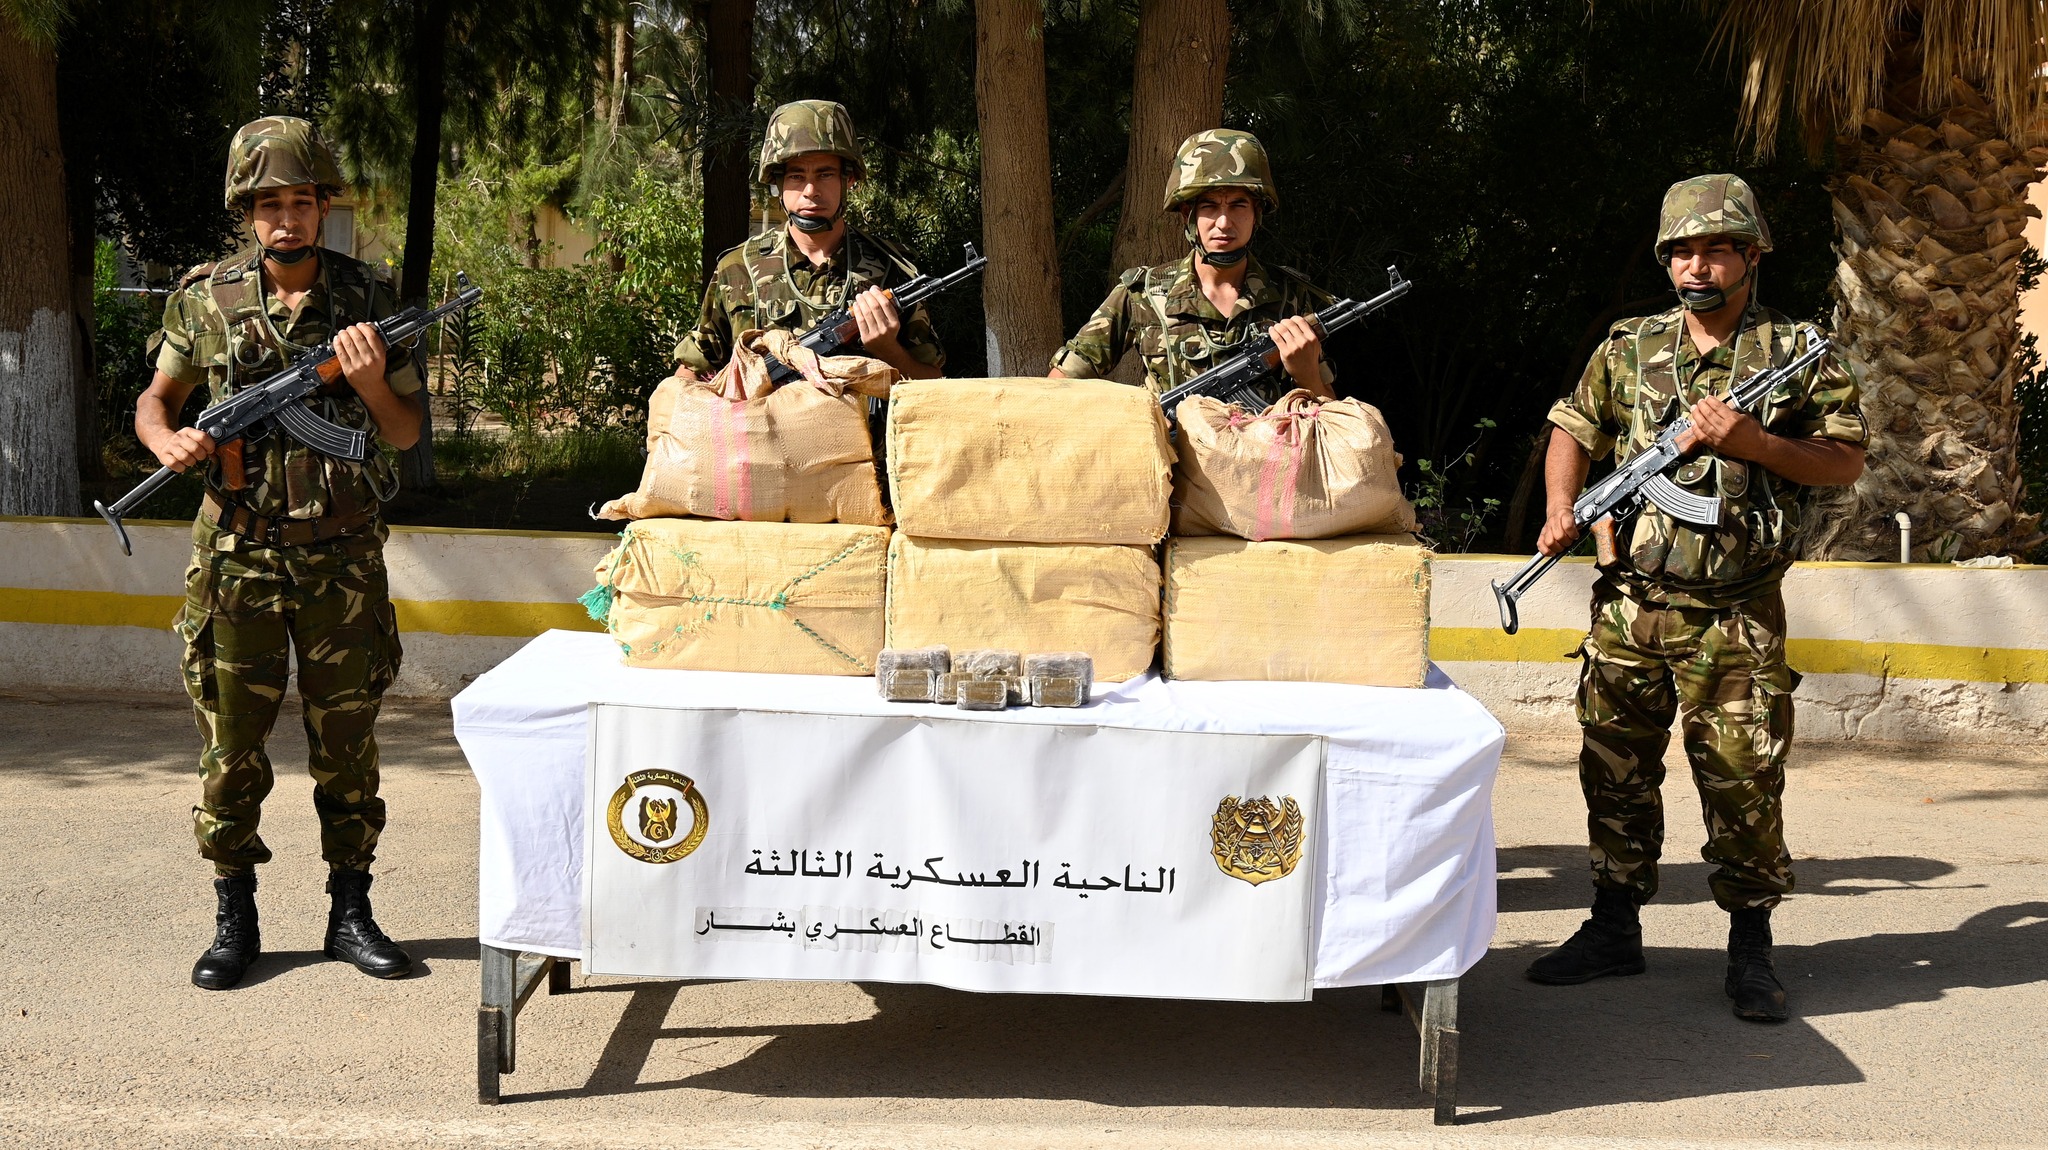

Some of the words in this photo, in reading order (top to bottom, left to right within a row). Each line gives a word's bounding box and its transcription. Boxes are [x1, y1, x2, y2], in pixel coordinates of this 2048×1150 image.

[744, 849, 852, 879] الثالثة
[867, 856, 1040, 890] العسكرية
[1053, 862, 1176, 899] الناحية
[695, 911, 796, 936] بشار
[805, 916, 923, 940] العسكري
[930, 922, 1040, 950] القطاع
